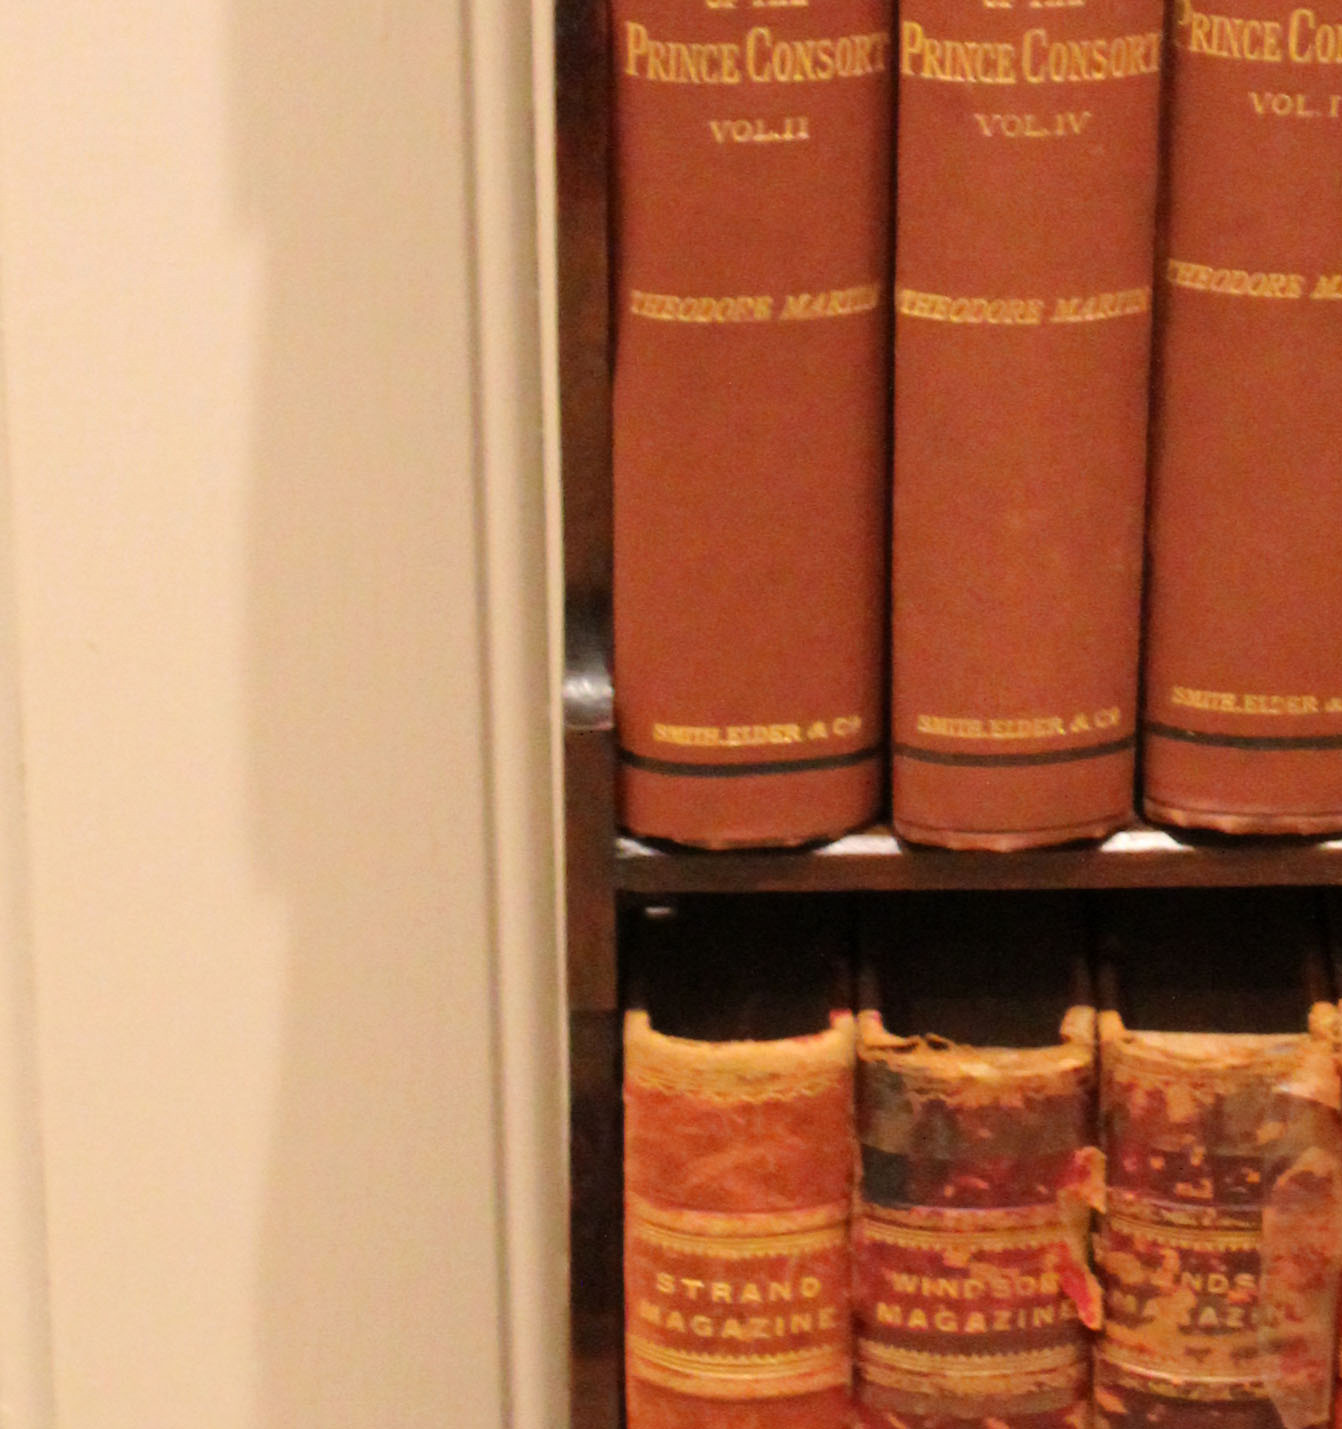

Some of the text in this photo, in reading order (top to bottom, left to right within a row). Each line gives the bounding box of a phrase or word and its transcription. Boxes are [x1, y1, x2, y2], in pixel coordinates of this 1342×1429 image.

[625, 21, 890, 85] PRINCE CONSORT
[902, 21, 1162, 84] PRINCE CONSORT
[1166, 260, 1304, 299] THEODORE
[630, 282, 881, 324] THEODORE MARTIN
[898, 285, 1150, 325] THEODORE MARTIN
[657, 1272, 822, 1303] STRAND
[889, 1272, 1059, 1300] WINDSOR
[640, 1300, 836, 1339] MAGAZINE
